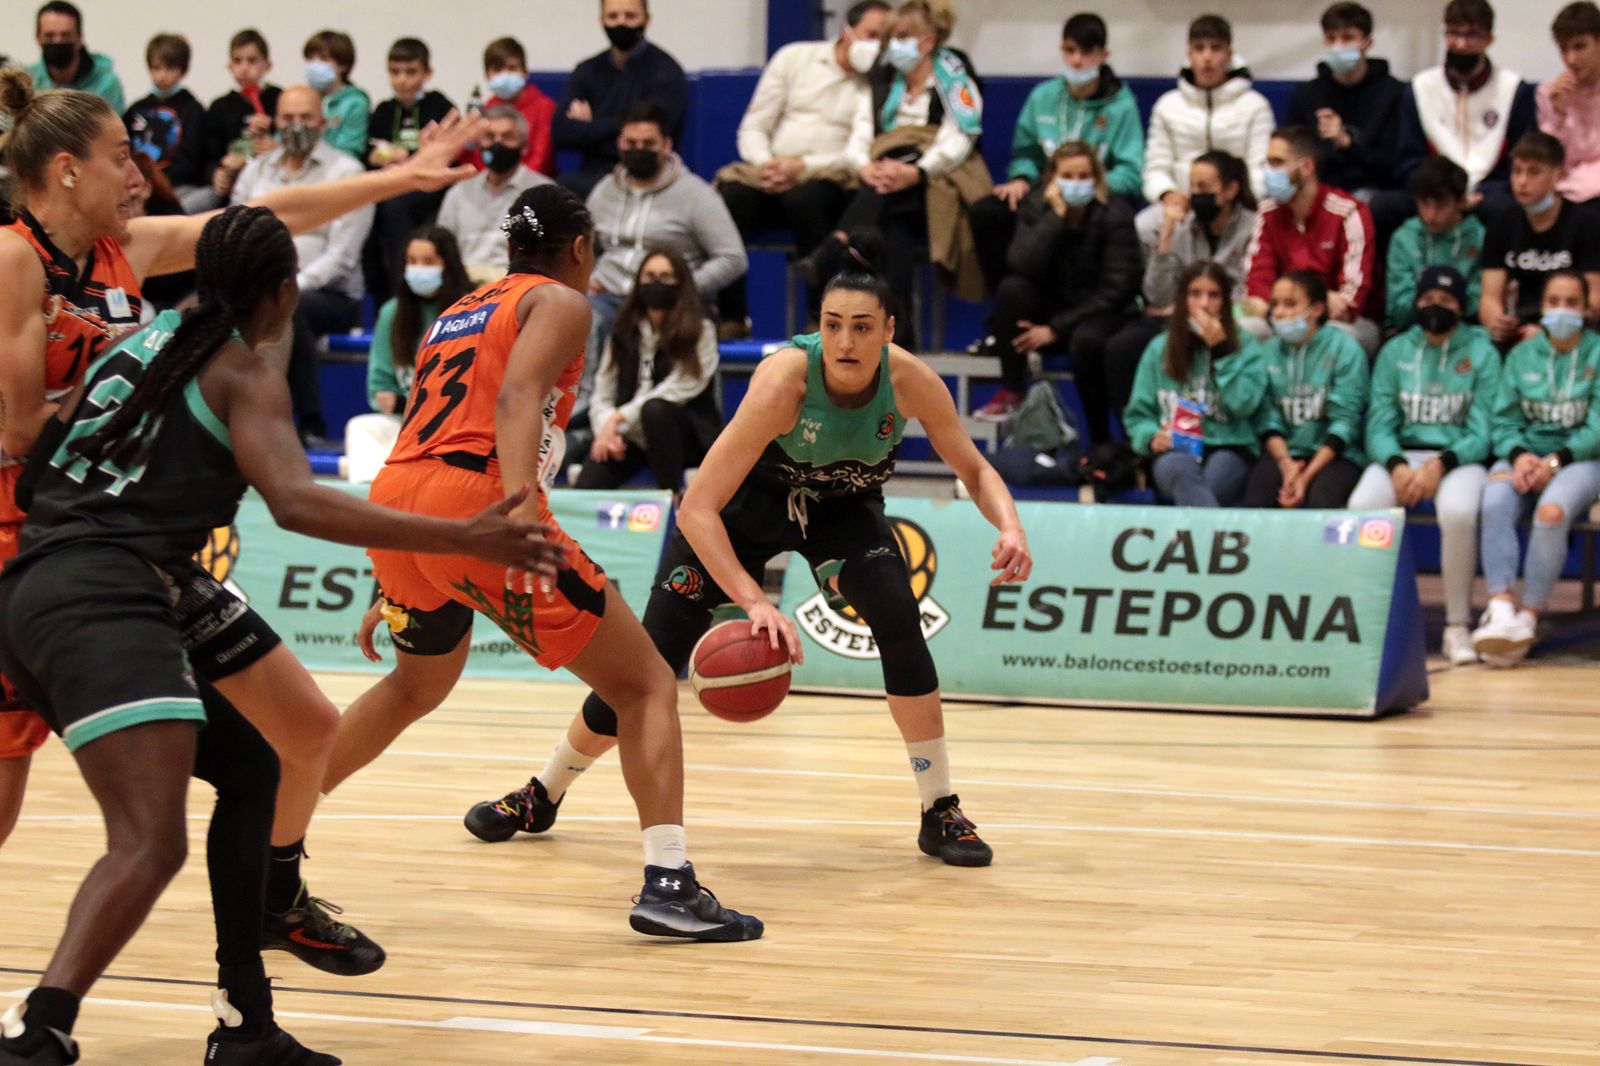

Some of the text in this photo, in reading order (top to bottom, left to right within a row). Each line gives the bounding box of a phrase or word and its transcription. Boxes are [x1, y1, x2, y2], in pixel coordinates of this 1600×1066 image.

[1112, 527, 1250, 576] CAB
[983, 583, 1361, 645] ESTEPONA
[1002, 653, 1331, 679] www.baloncestoestepona.com
